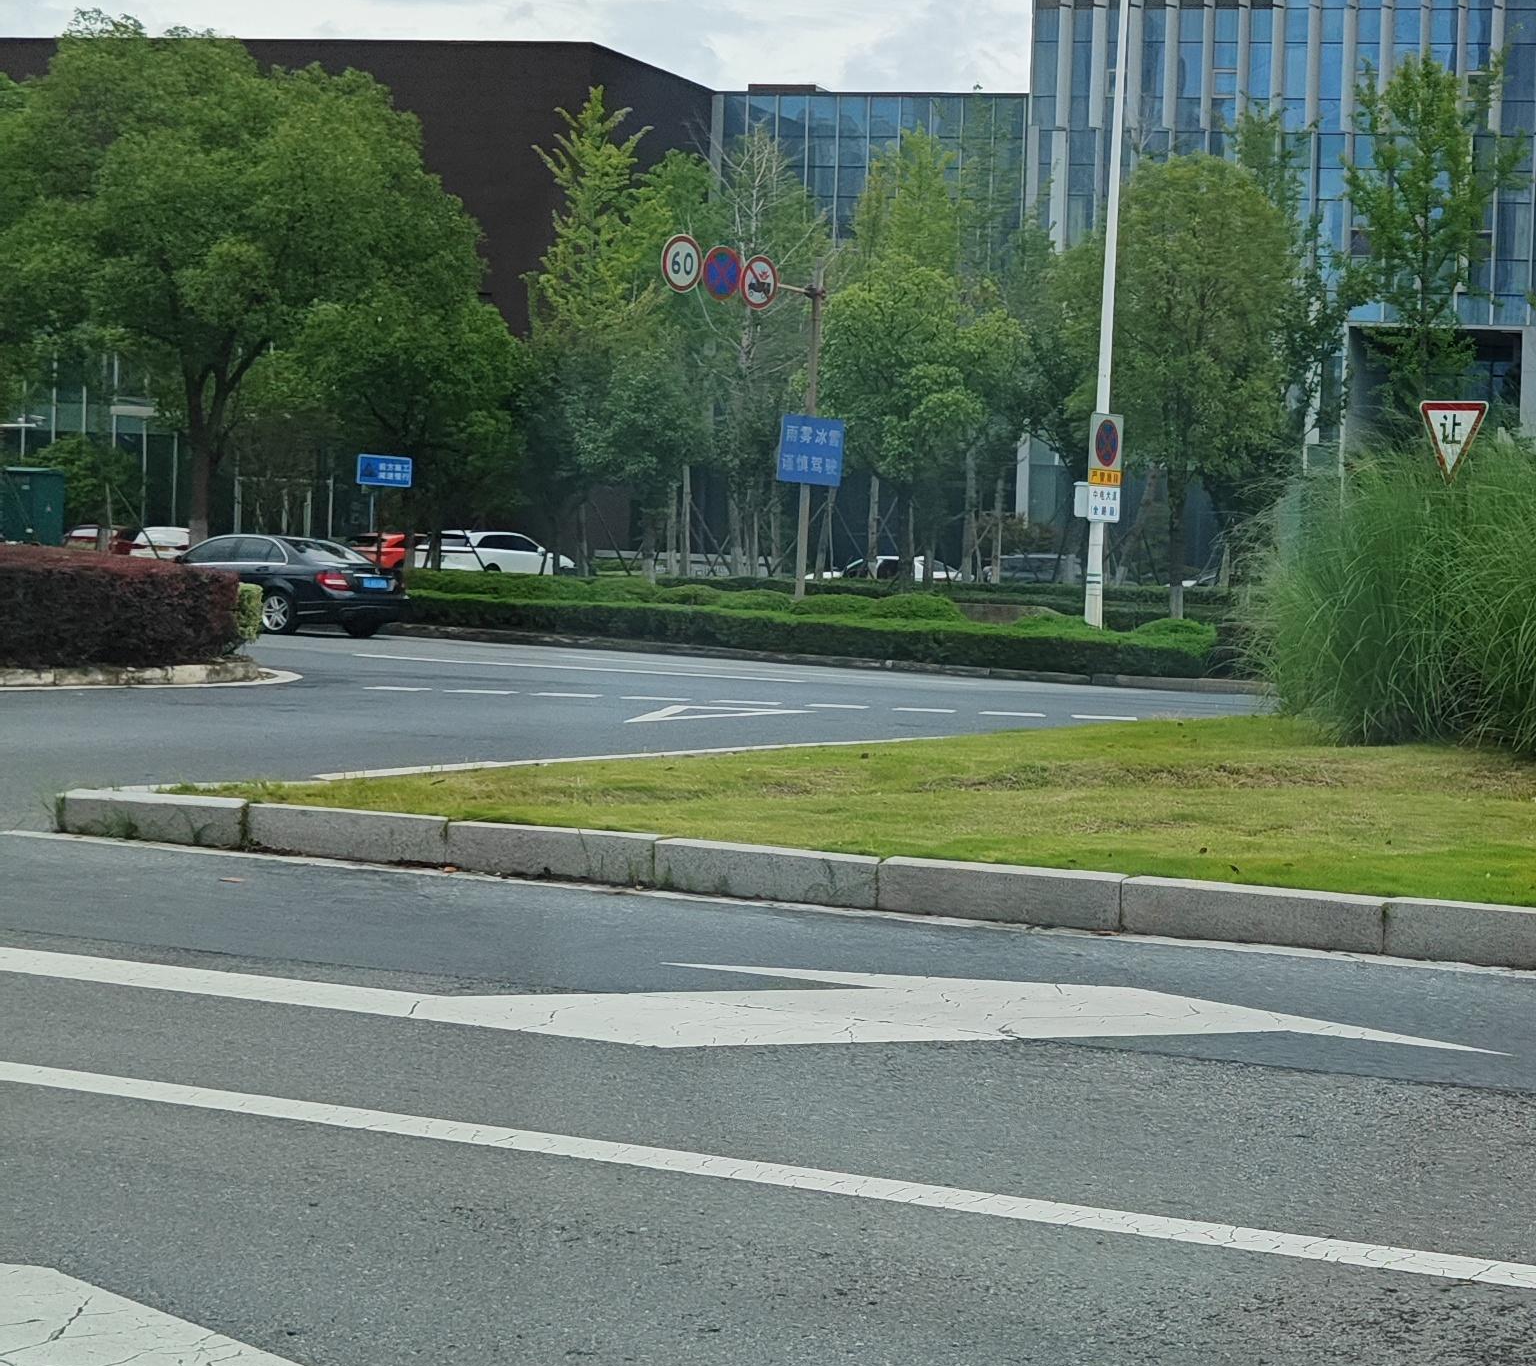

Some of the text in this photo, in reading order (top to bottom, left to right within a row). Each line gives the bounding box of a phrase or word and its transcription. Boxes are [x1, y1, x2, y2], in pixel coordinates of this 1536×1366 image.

[671, 251, 693, 276] 60
[786, 425, 841, 447] 雨雾冰雪
[1440, 414, 1461, 444] 让
[783, 454, 838, 475] 谨慎驾驶
[1093, 490, 1117, 500] 中电大道
